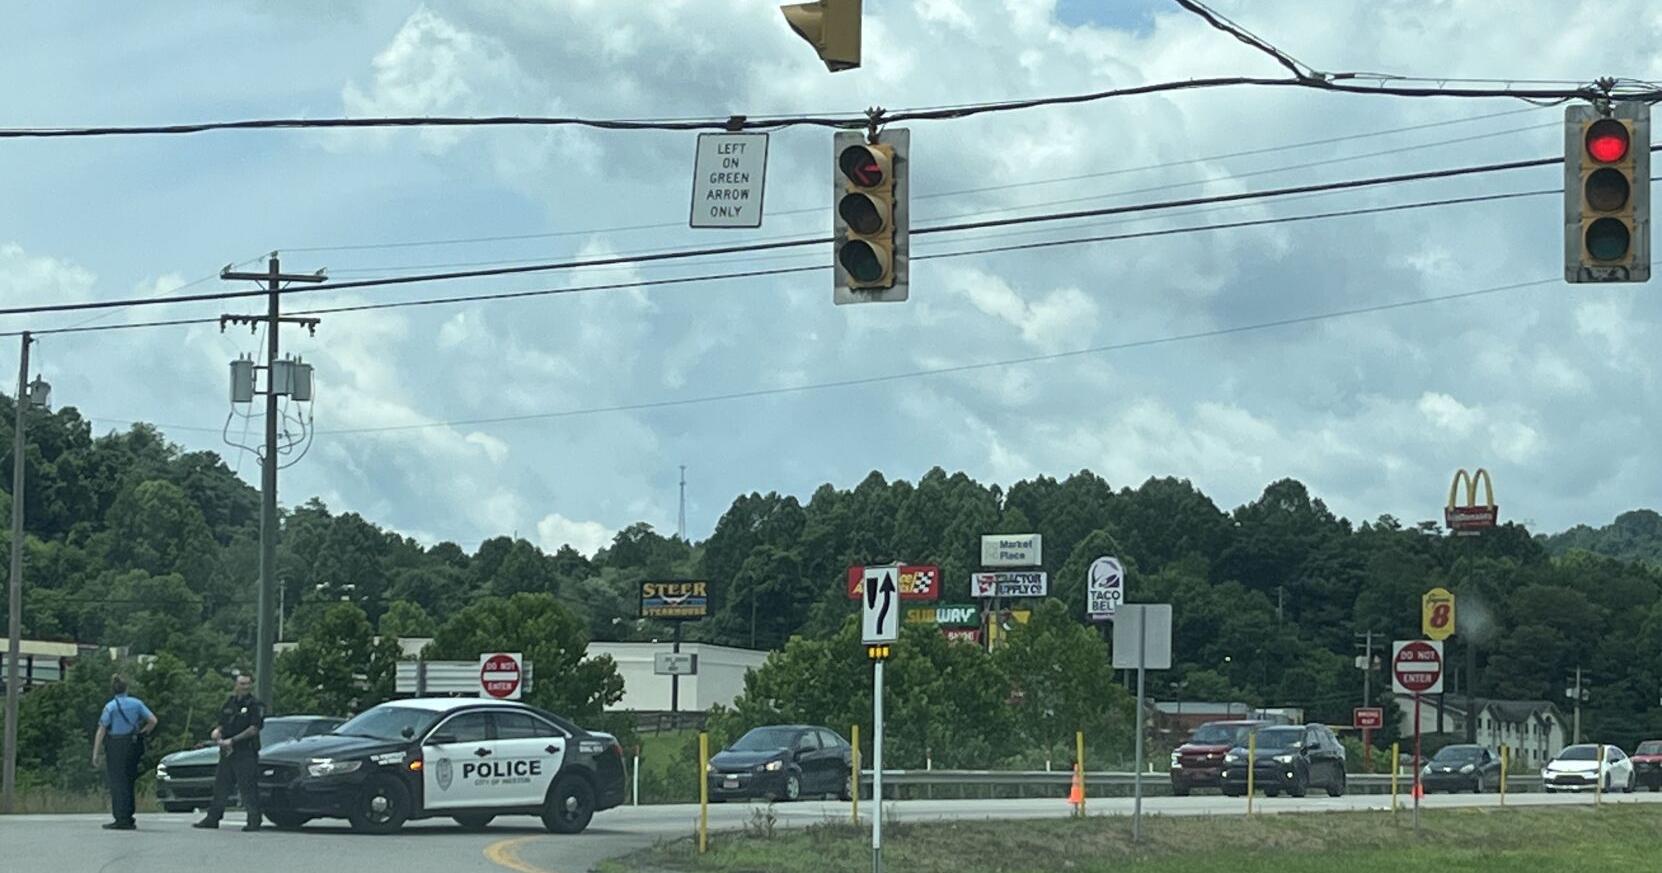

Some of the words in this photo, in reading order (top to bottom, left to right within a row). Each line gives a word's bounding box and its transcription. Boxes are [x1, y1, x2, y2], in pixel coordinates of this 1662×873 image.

[718, 143, 746, 154] LEFT
[723, 157, 740, 169] ON
[709, 172, 750, 184] GREEN
[706, 188, 750, 201] ARROW
[710, 206, 743, 217] ONLY
[1000, 540, 1033, 549] Market
[1000, 551, 1026, 560] Place
[642, 581, 707, 598] STEER
[1090, 590, 1121, 600] TACO
[905, 607, 976, 624] SUBWAY
[1430, 604, 1451, 629] 8
[1400, 650, 1414, 660] DO
[1417, 650, 1436, 660] NOT
[485, 661, 497, 670] DO
[500, 661, 516, 670] NOT
[1403, 673, 1432, 683] ENTER
[487, 681, 512, 691] ENTER
[463, 760, 542, 779] POLICE
[474, 778, 489, 786] CITY
